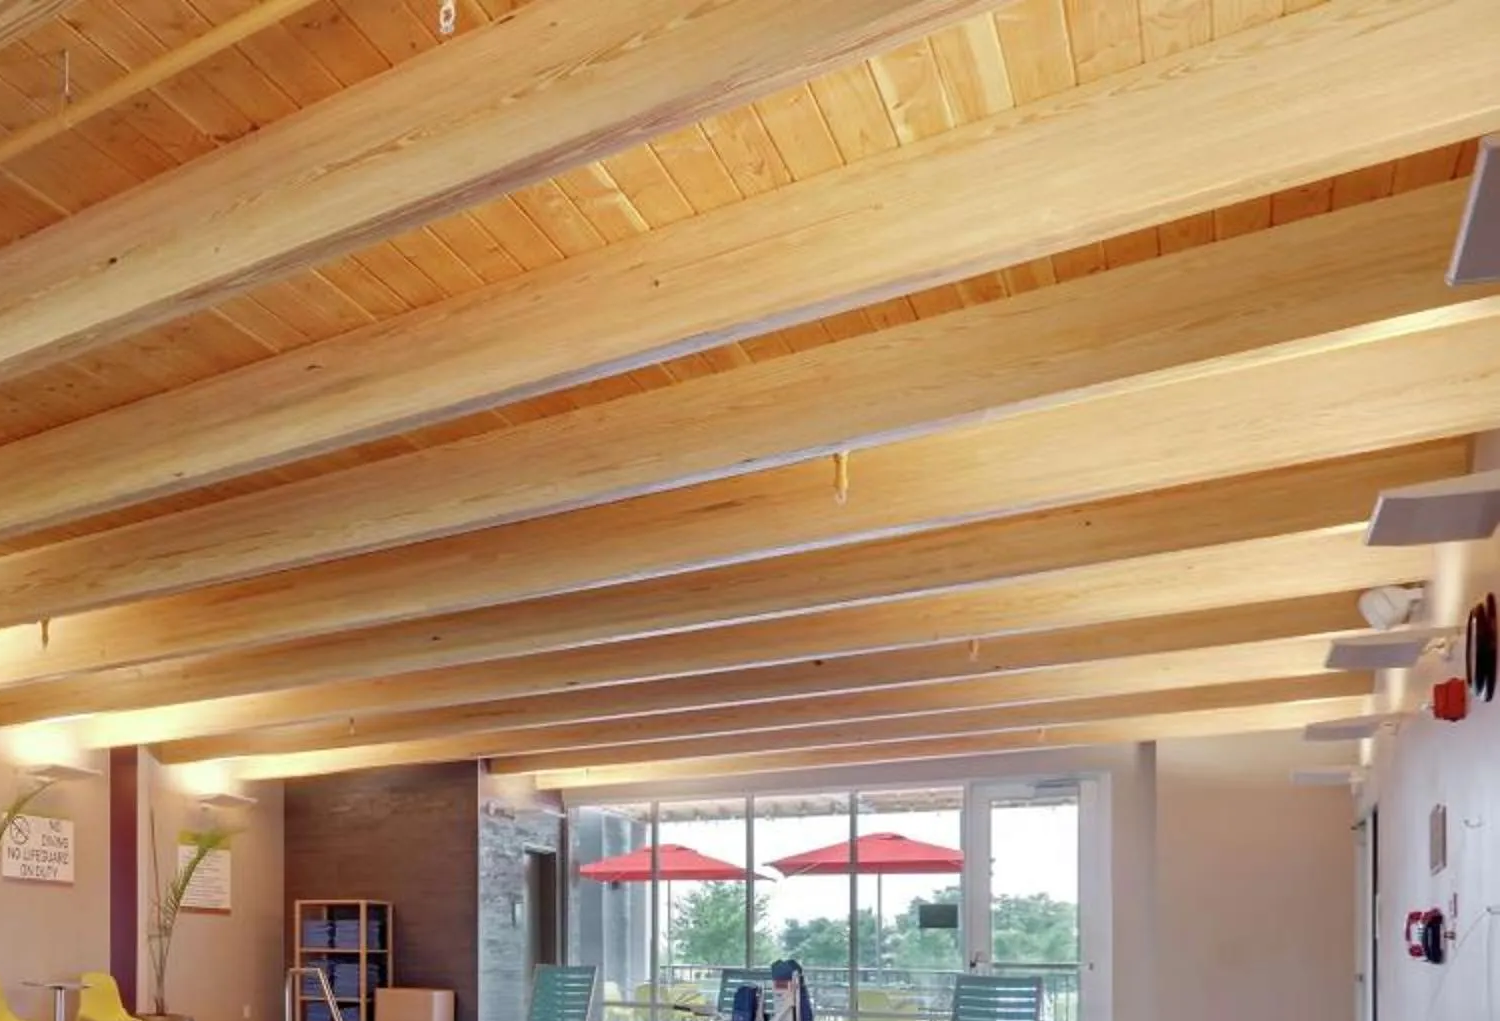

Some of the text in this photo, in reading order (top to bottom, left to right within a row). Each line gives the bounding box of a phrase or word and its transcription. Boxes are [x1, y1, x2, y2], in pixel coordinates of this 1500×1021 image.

[7, 847, 70, 865] NO LIFEGUARD
[19, 863, 59, 878] ON DUTY
